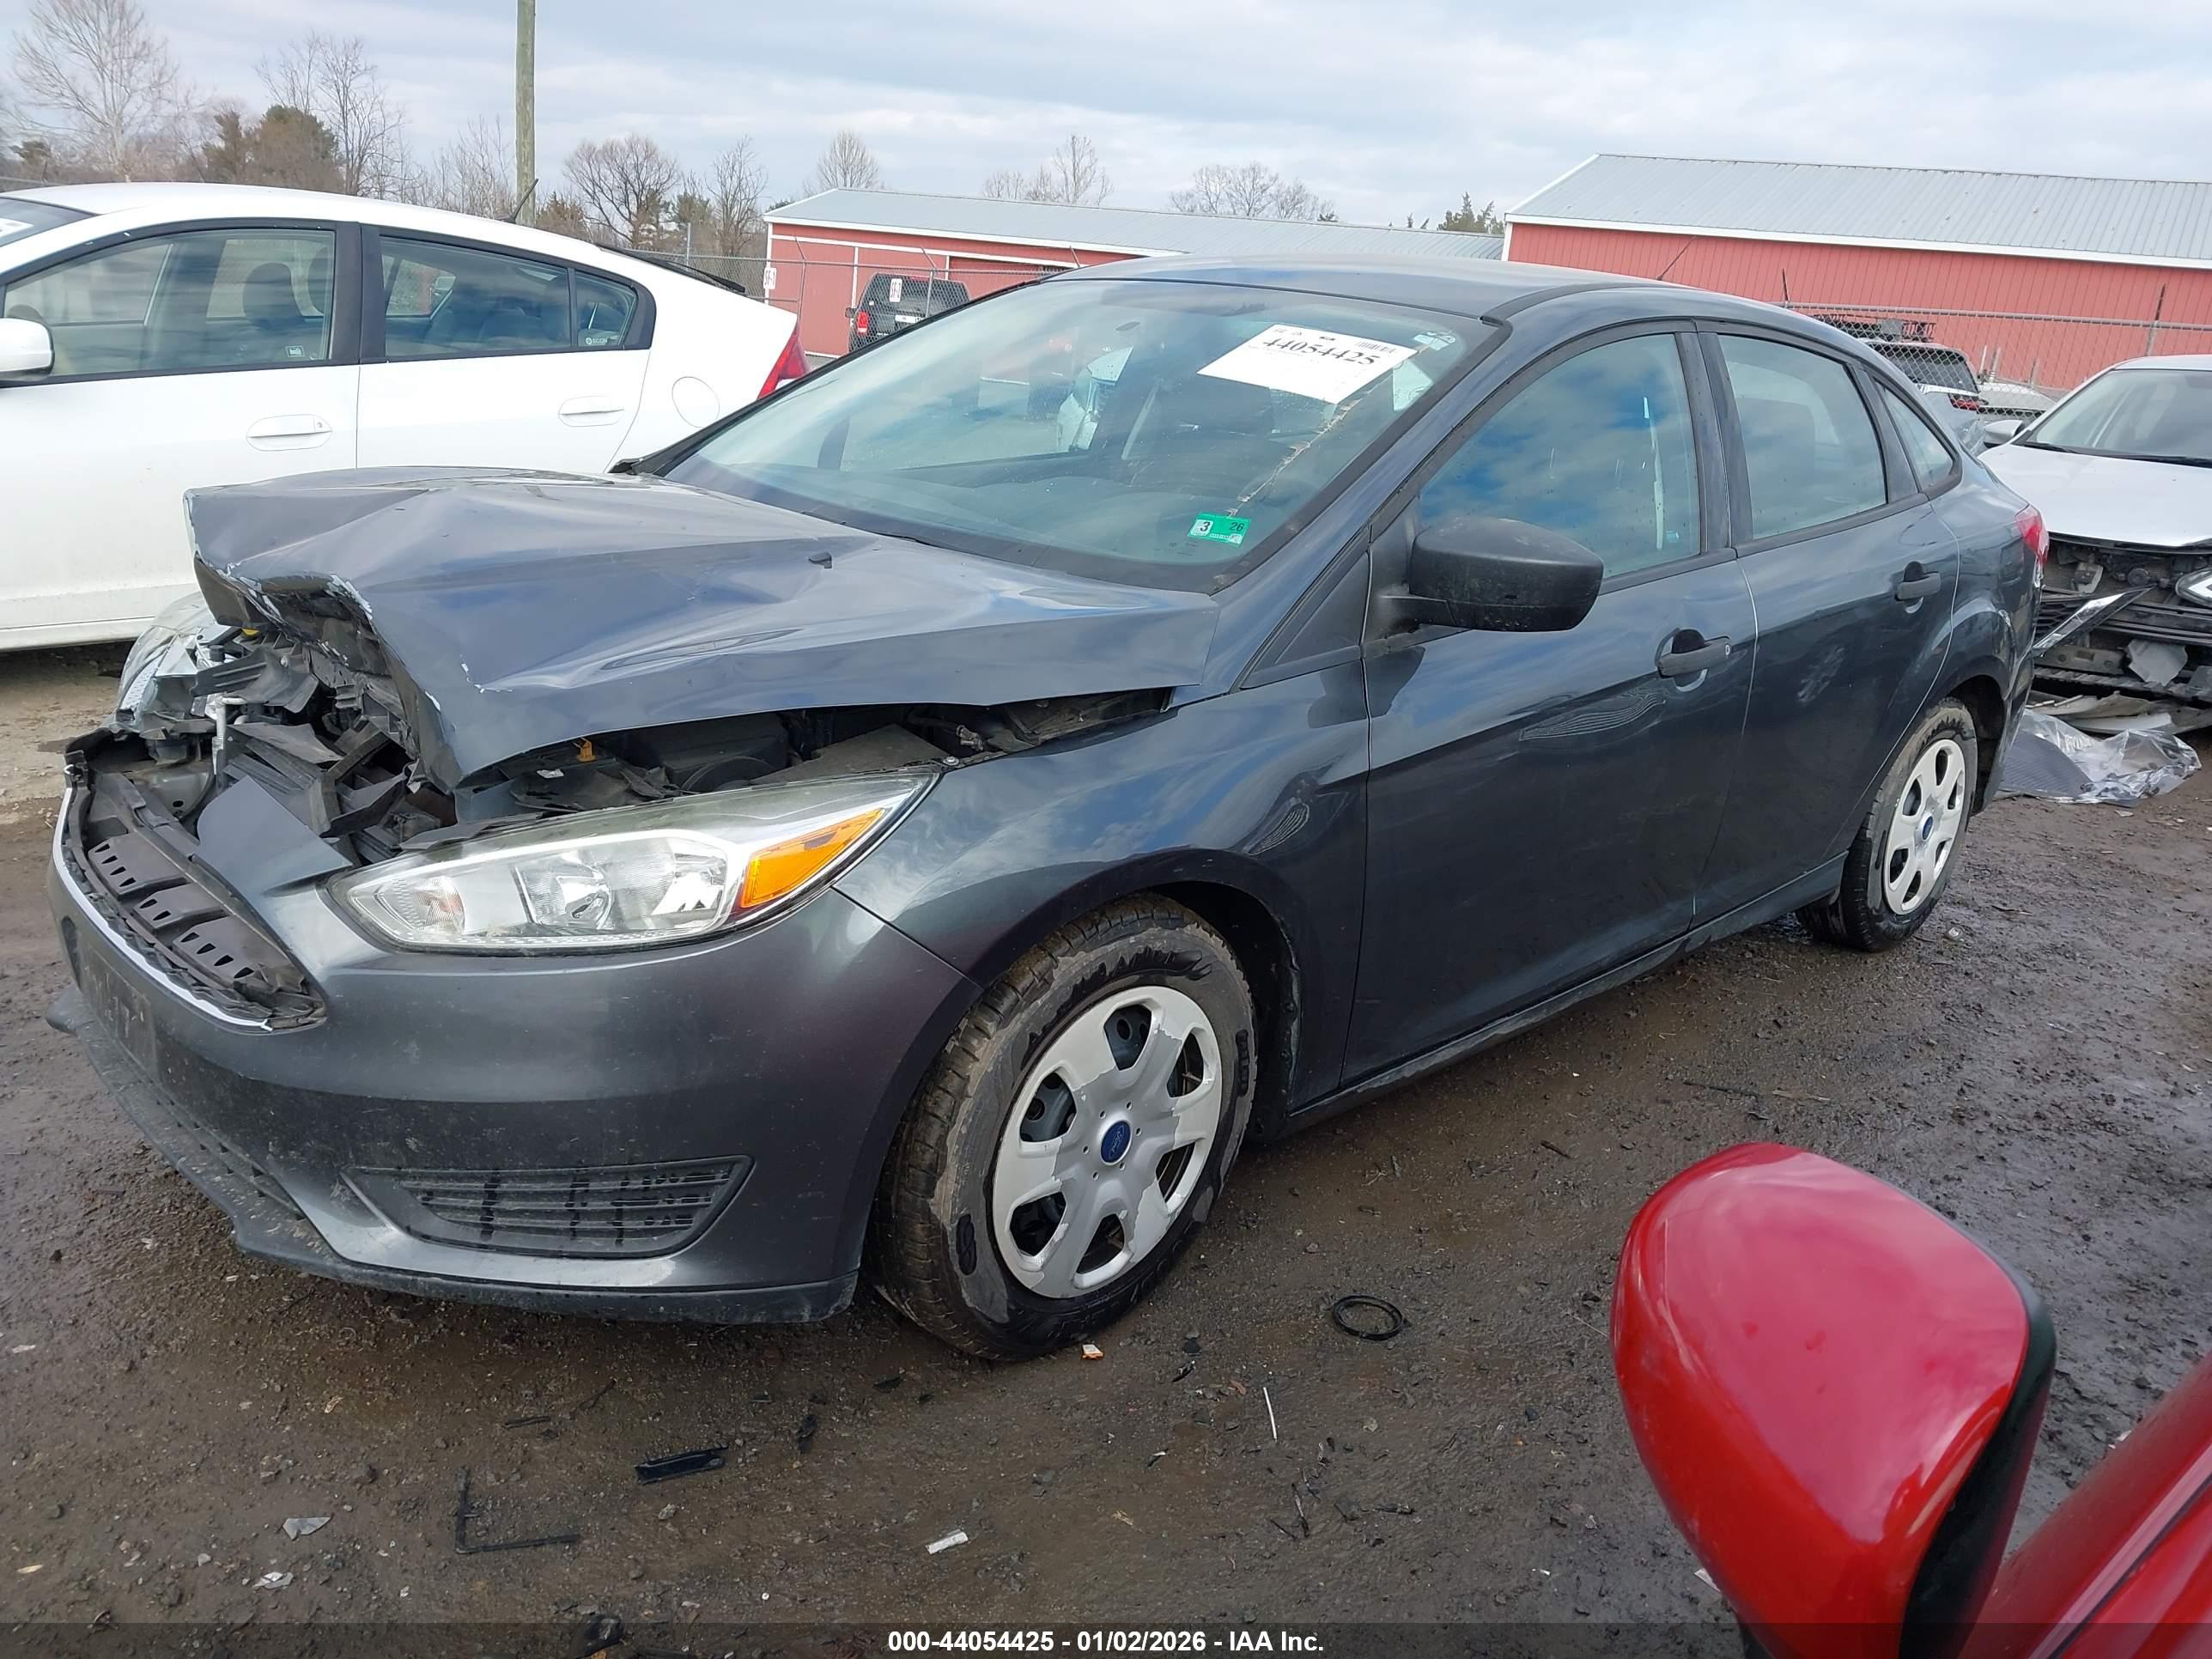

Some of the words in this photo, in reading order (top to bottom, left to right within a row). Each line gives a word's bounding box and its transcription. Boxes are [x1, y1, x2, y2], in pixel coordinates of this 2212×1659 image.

[1262, 337, 1381, 365] 44054425
[1200, 521, 1211, 532] 3
[1229, 521, 1245, 532] 26
